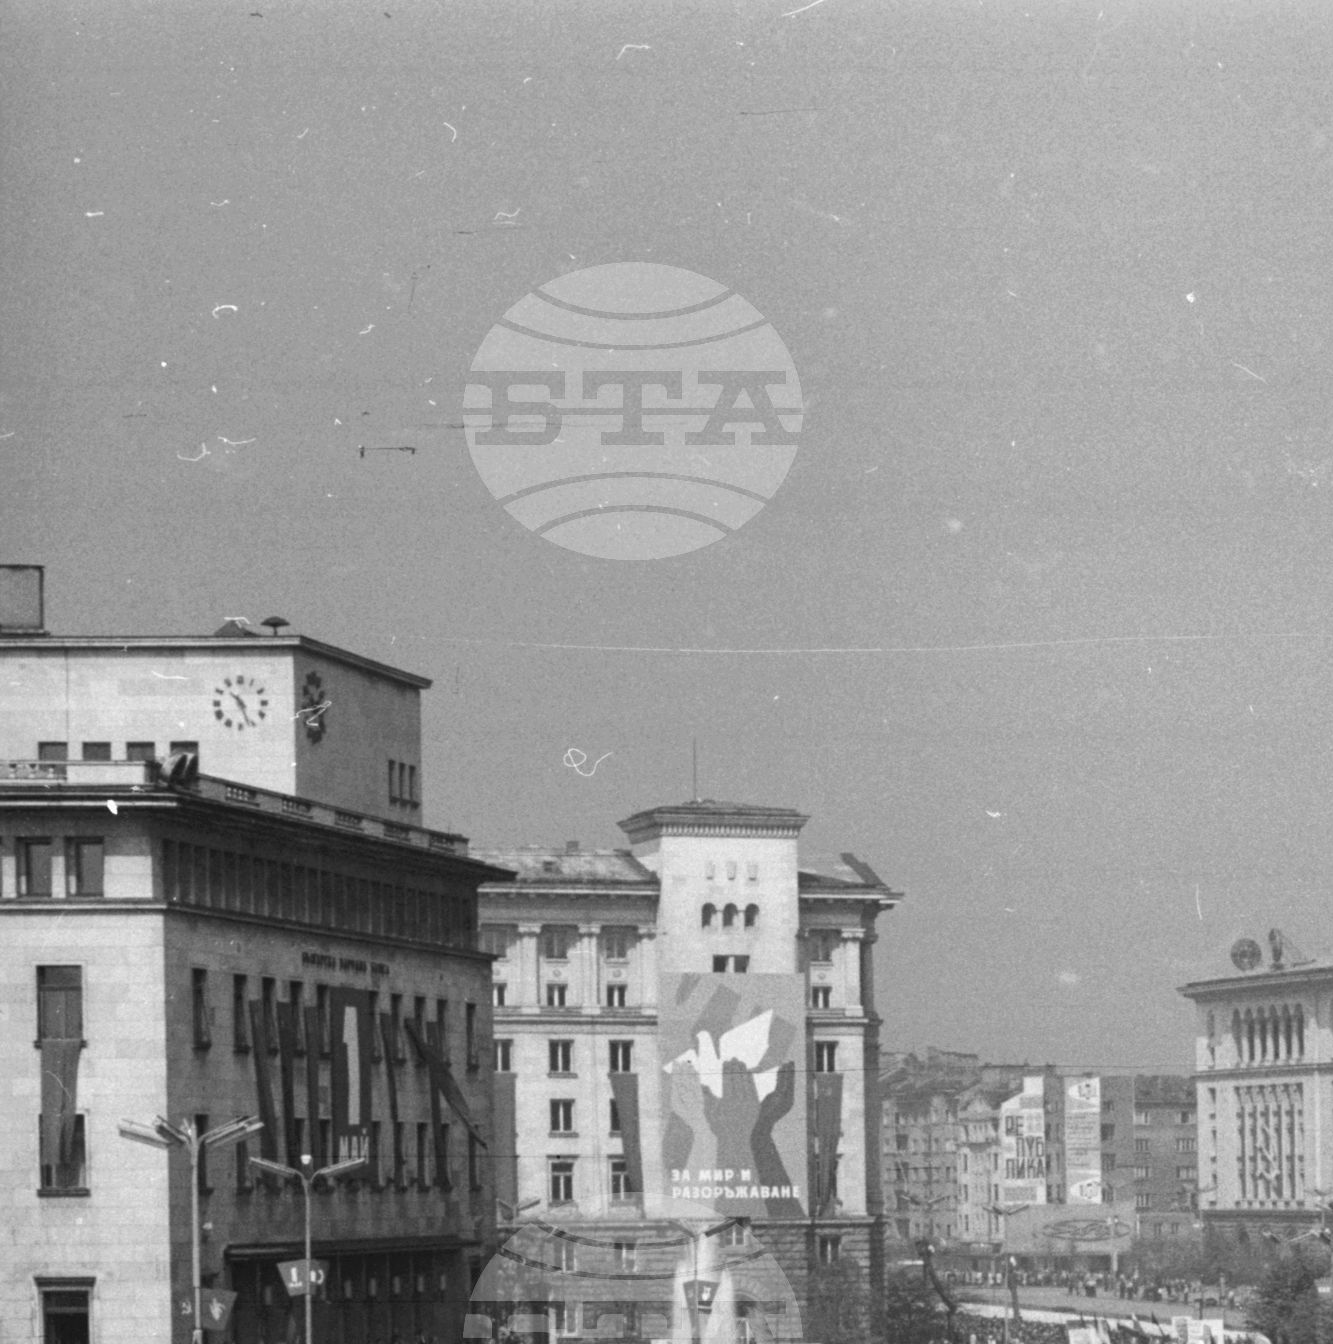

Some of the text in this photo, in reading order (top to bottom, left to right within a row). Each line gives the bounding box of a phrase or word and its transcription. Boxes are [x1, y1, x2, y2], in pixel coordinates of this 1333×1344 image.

[671, 1168, 751, 1181] ЗА МИР И
[672, 1185, 801, 1199] РАЗОРЪЖАВАНЕ
